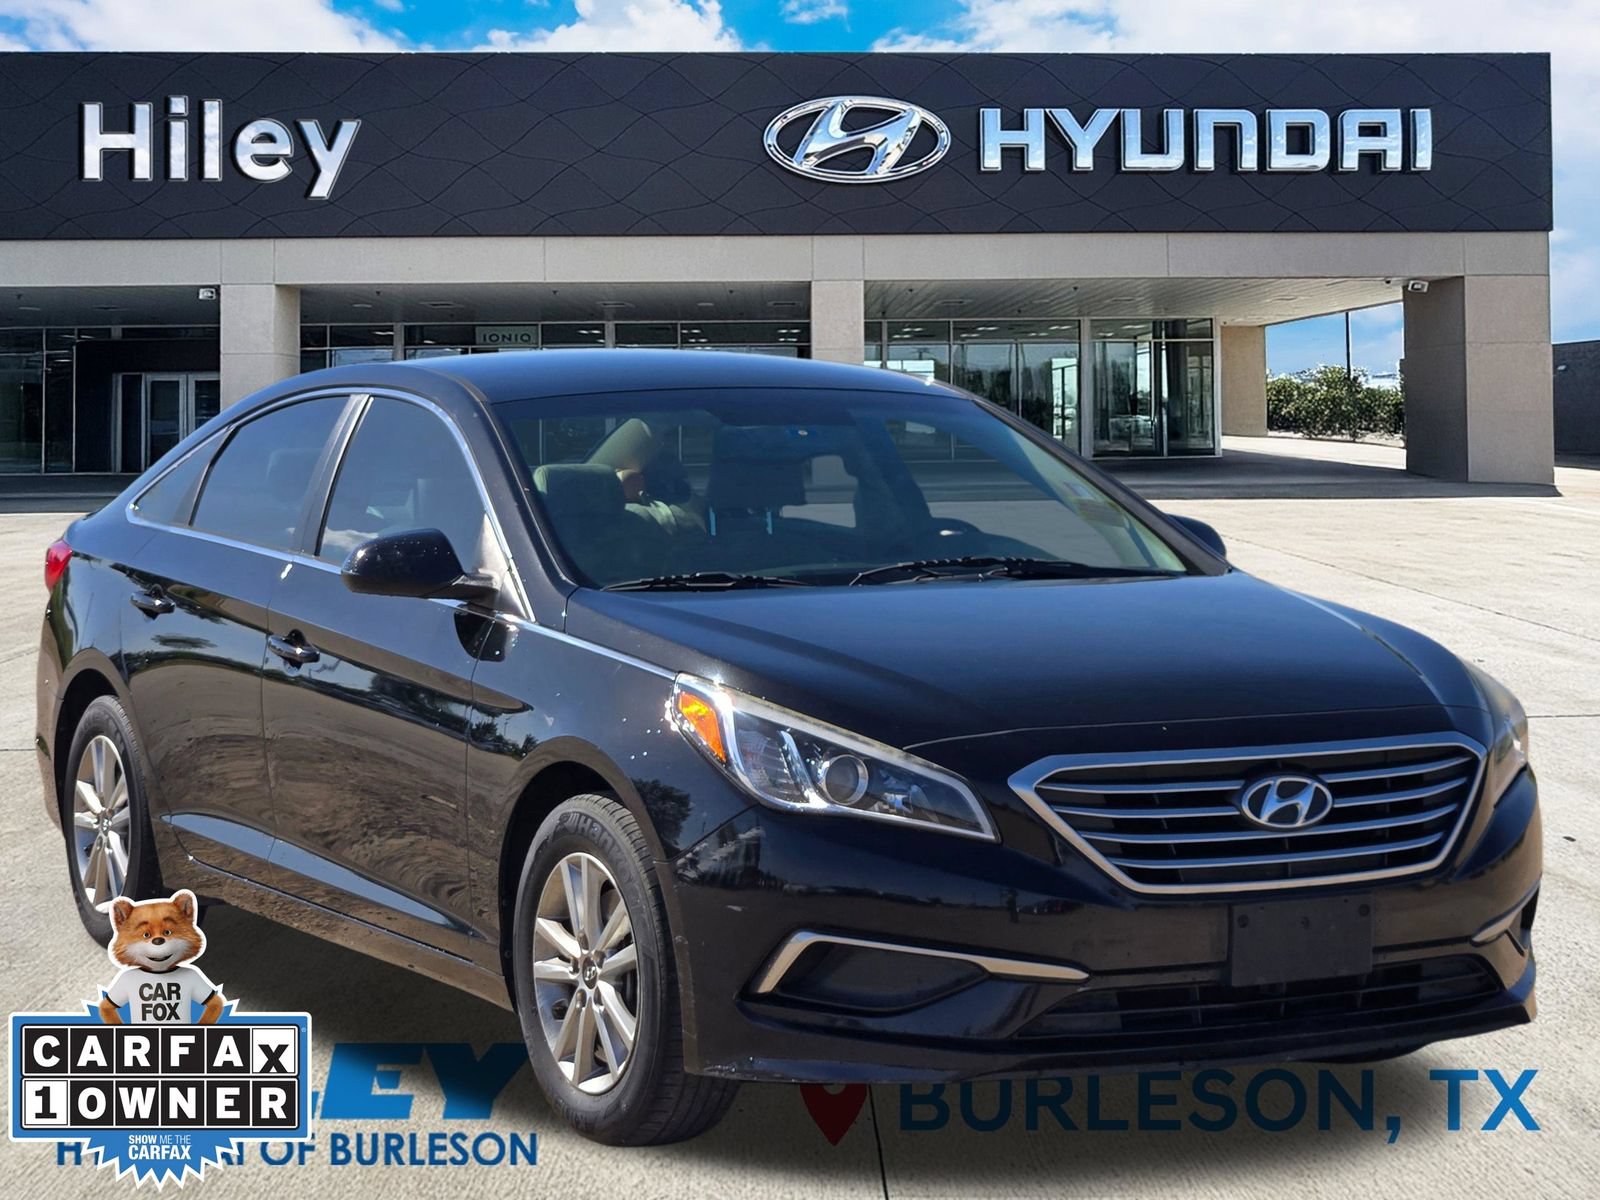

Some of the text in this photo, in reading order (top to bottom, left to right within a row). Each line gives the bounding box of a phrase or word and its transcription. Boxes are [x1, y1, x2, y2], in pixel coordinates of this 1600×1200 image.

[79, 95, 361, 200] Hiley
[979, 108, 1432, 172] HYUNDAI
[483, 332, 532, 343] IONIQ
